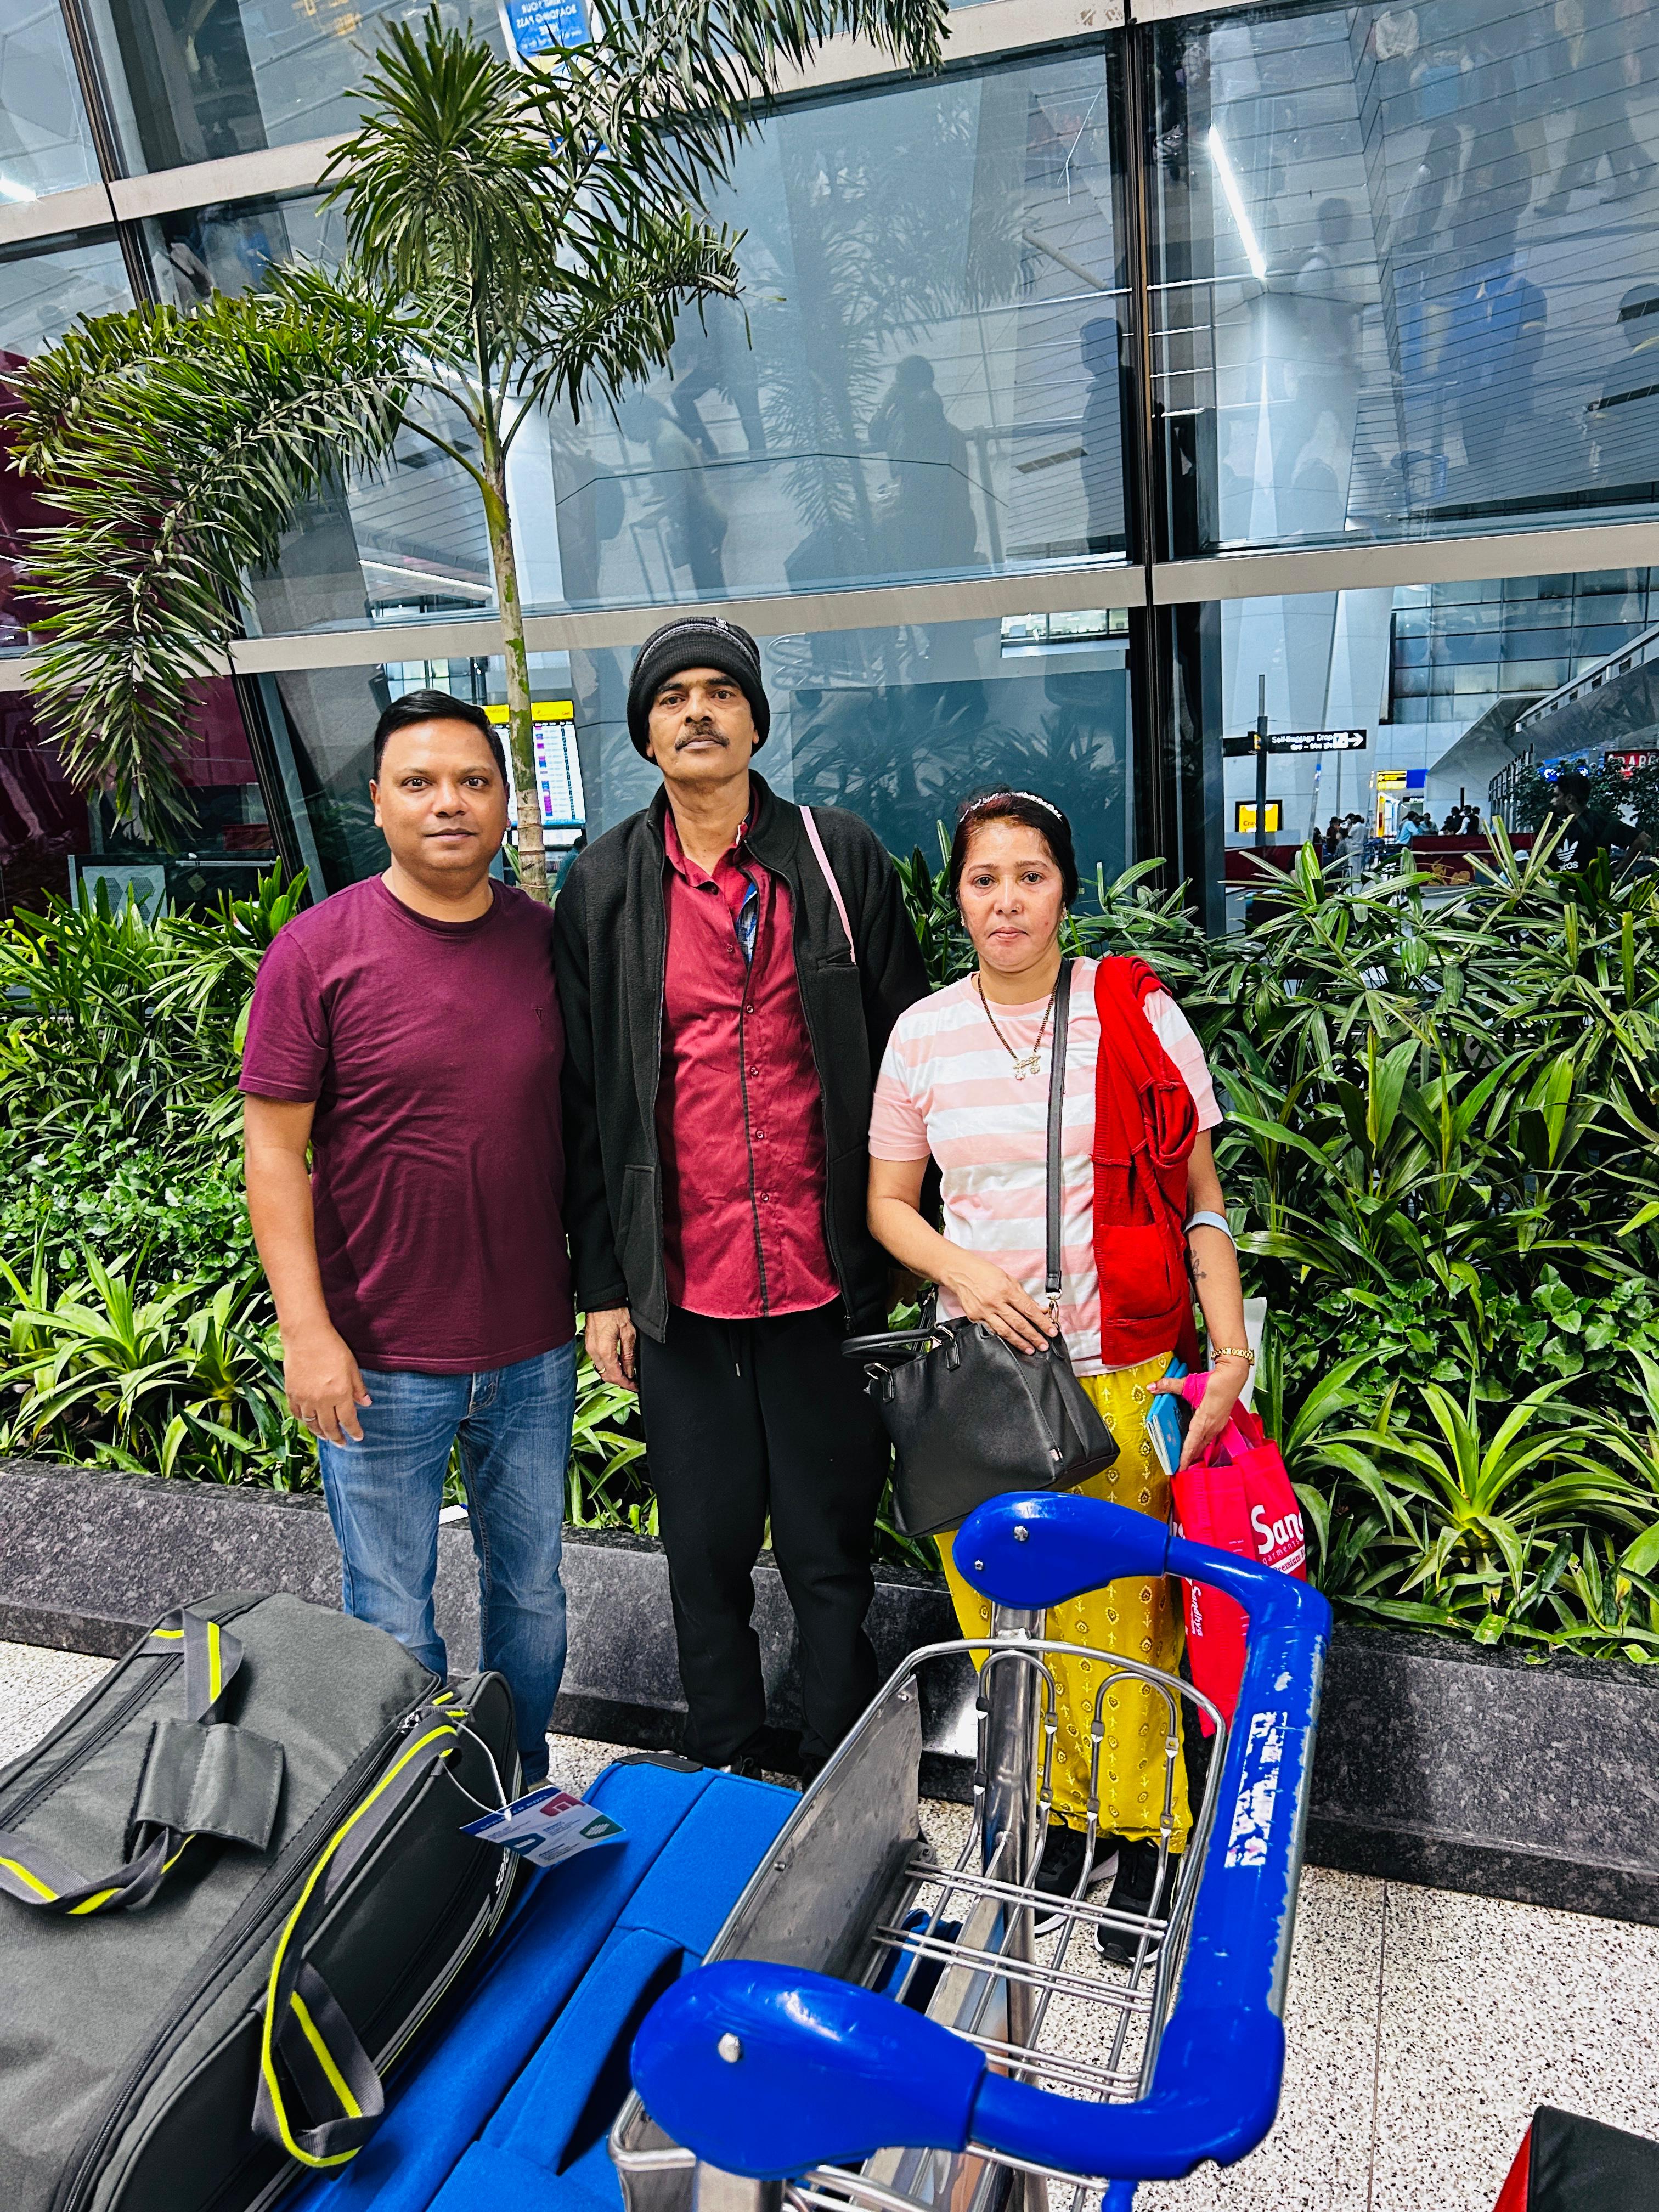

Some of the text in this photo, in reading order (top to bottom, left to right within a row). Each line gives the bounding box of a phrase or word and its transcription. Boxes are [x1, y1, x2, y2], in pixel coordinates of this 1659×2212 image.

[1272, 735, 1315, 743] Self-Baggage
[1262, 1538, 1300, 1566] garments
[1191, 1585, 1203, 1637] Sandhya
